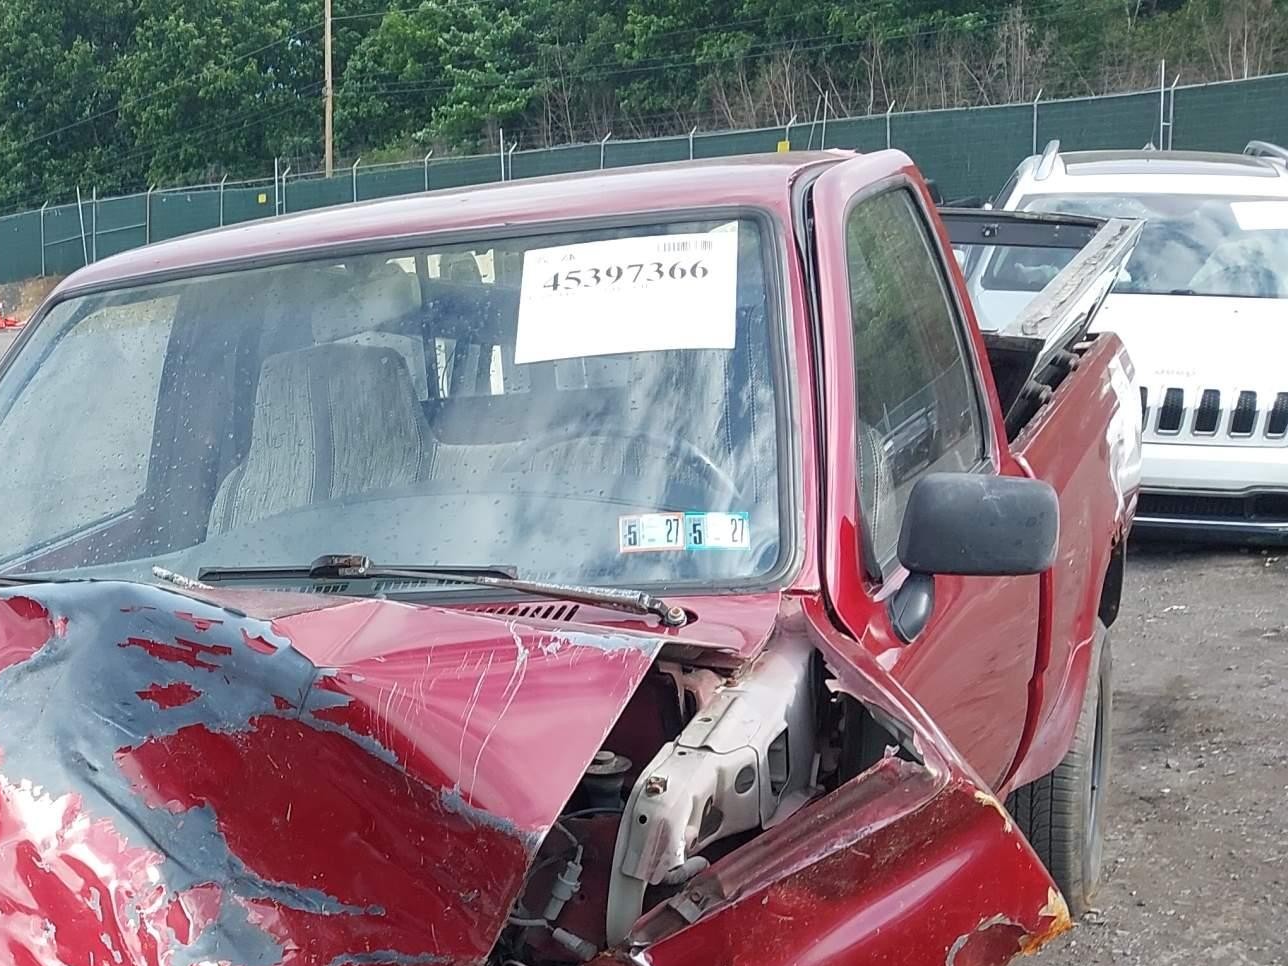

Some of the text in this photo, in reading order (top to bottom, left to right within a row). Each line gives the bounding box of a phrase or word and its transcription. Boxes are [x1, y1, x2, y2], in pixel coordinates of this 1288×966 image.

[543, 260, 709, 291] 45397366
[627, 518, 680, 546] 5 27
[692, 518, 745, 545] 5 27
